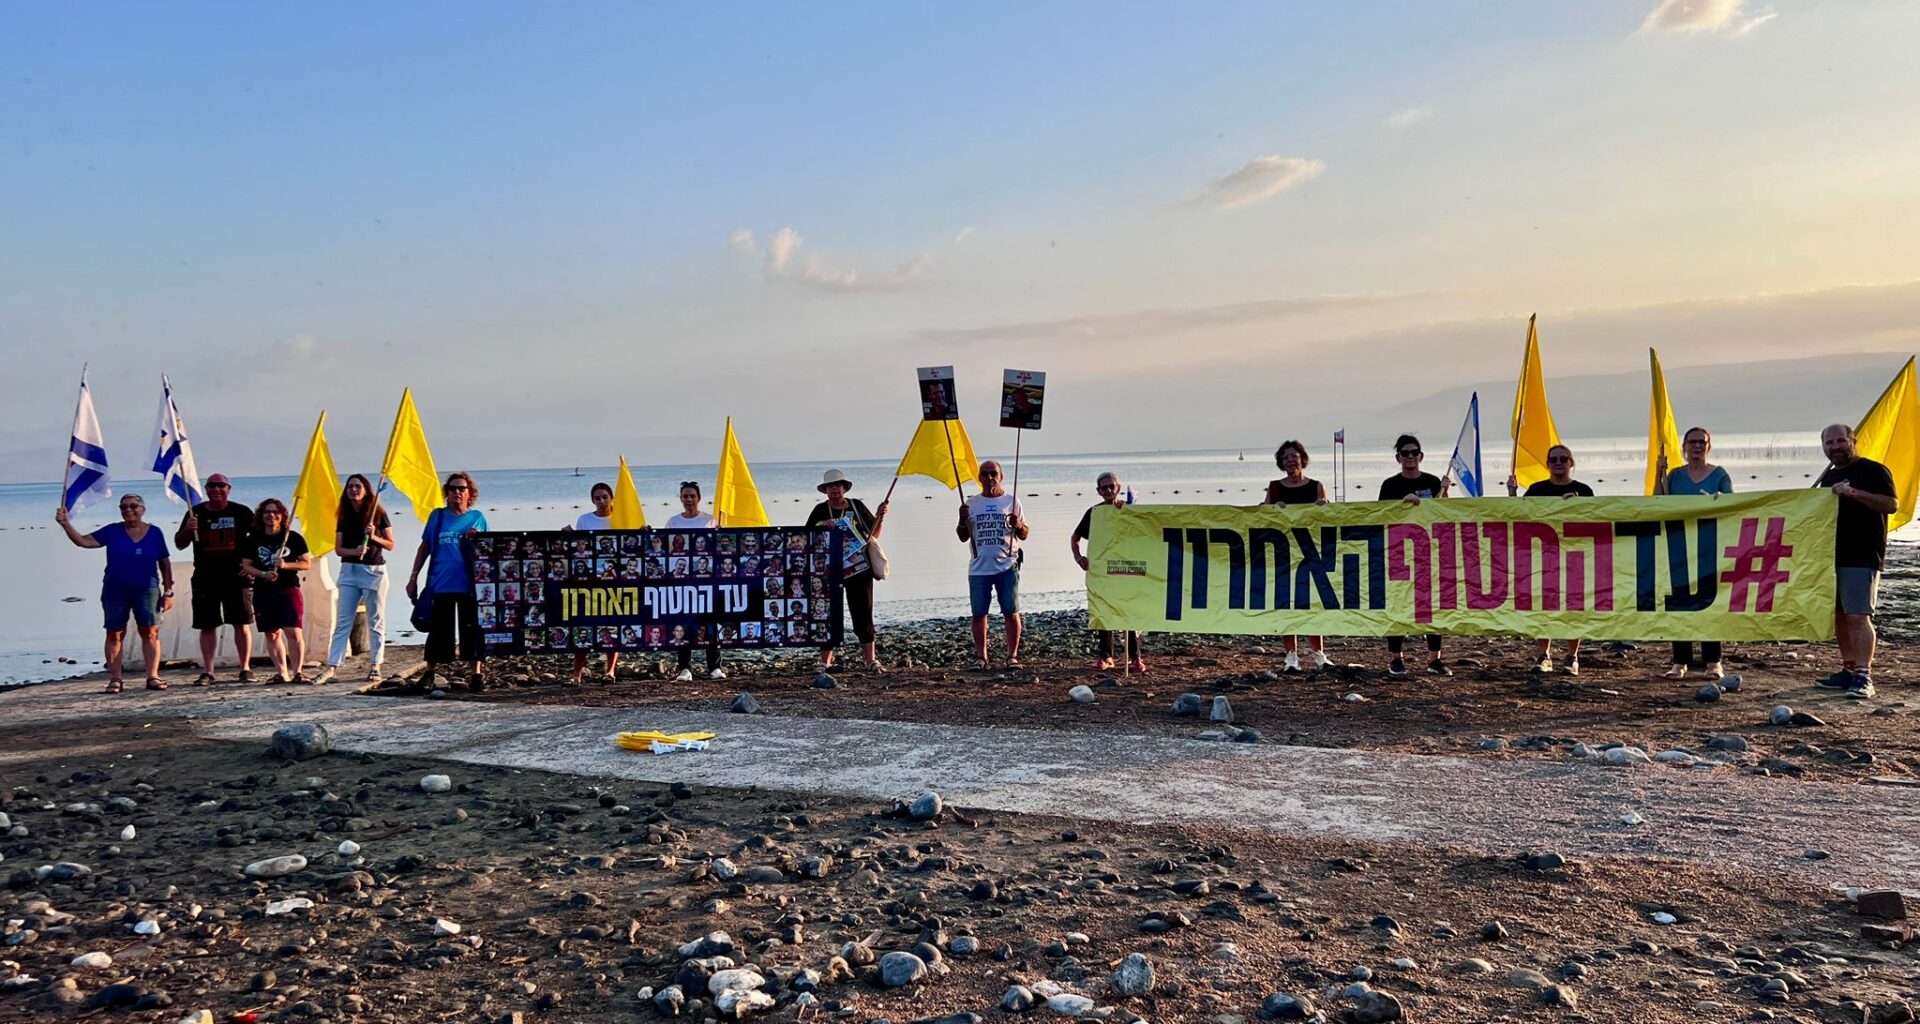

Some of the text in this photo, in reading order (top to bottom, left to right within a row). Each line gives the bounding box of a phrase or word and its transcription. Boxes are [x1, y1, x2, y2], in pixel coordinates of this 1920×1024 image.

[561, 584, 748, 621] עד החטוף האחרון
[1163, 524, 1386, 621] האחרון
[1387, 521, 1614, 624] החטוף
